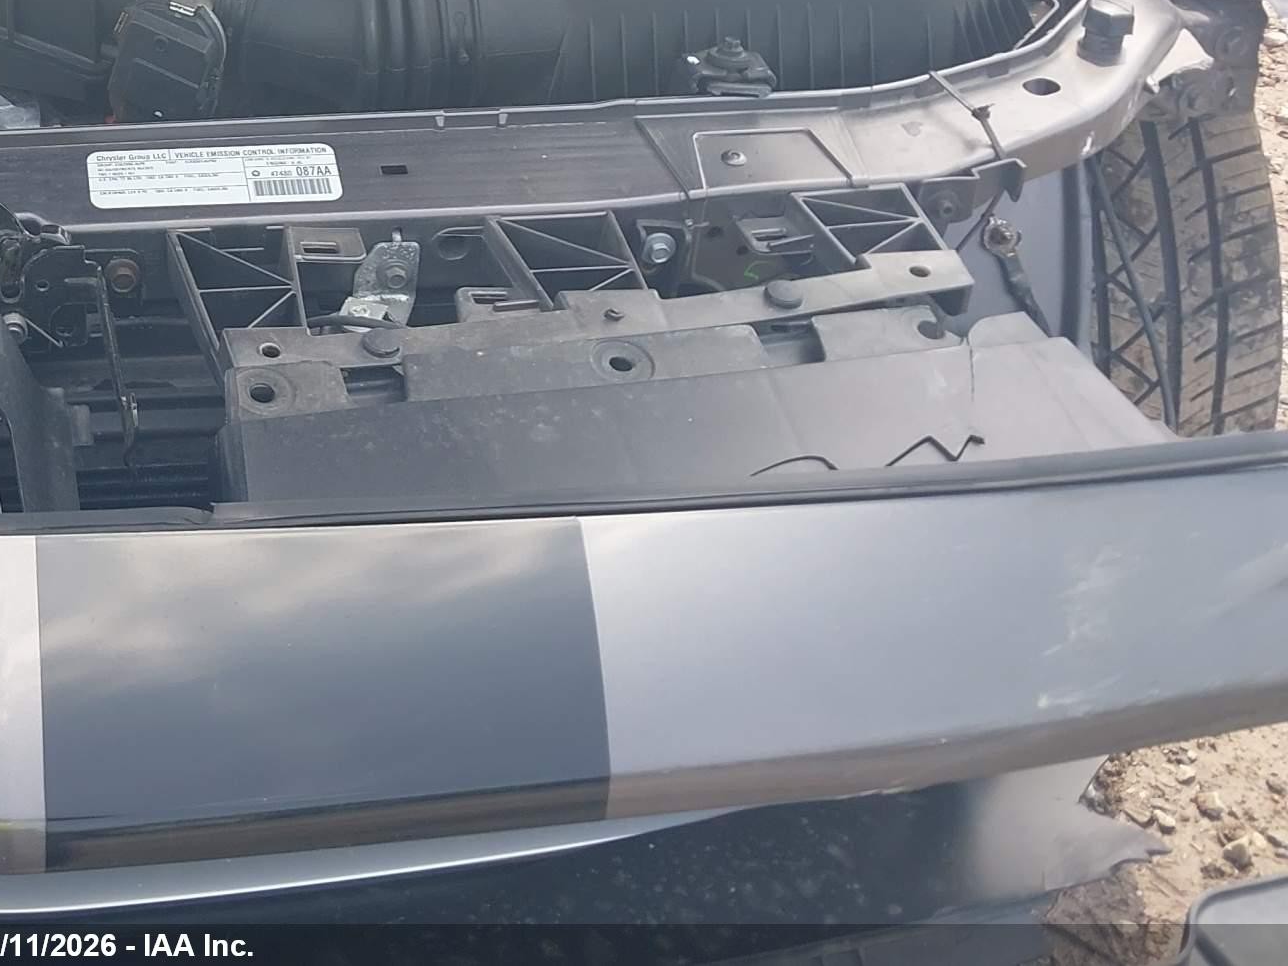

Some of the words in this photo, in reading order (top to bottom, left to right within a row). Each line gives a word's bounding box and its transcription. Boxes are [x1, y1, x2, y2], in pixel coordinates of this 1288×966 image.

[96, 154, 126, 162] Chrysler
[128, 153, 151, 161] Group
[174, 151, 203, 159] VEHICLE
[206, 149, 241, 157] EMISSION
[277, 147, 327, 155] INFORMATION
[295, 165, 332, 177] 087AA
